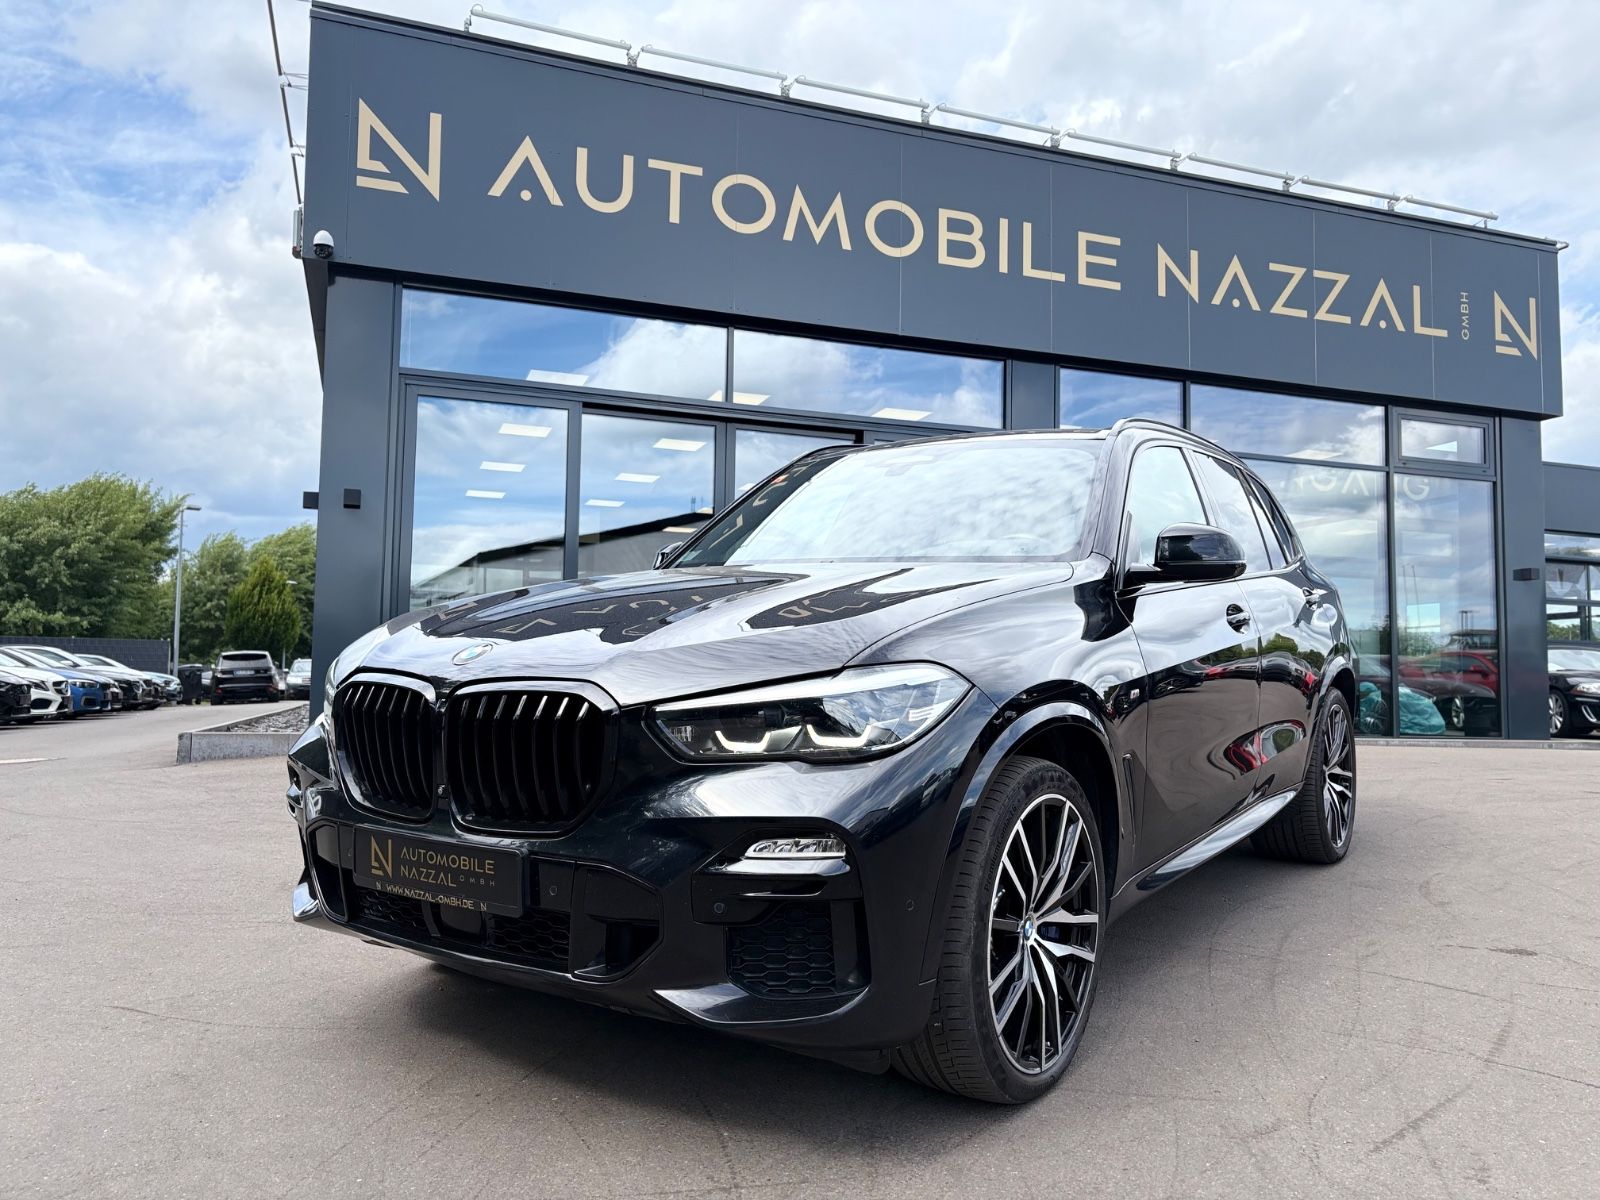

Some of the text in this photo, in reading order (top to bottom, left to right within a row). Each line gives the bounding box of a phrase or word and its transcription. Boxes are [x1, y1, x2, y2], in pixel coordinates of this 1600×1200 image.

[487, 135, 1448, 338] AUTOMOBILE NAZZAL
[1460, 291, 1470, 341] GMBH
[400, 847, 495, 875] AUTOMOBILE
[400, 865, 457, 888] NAZZAL
